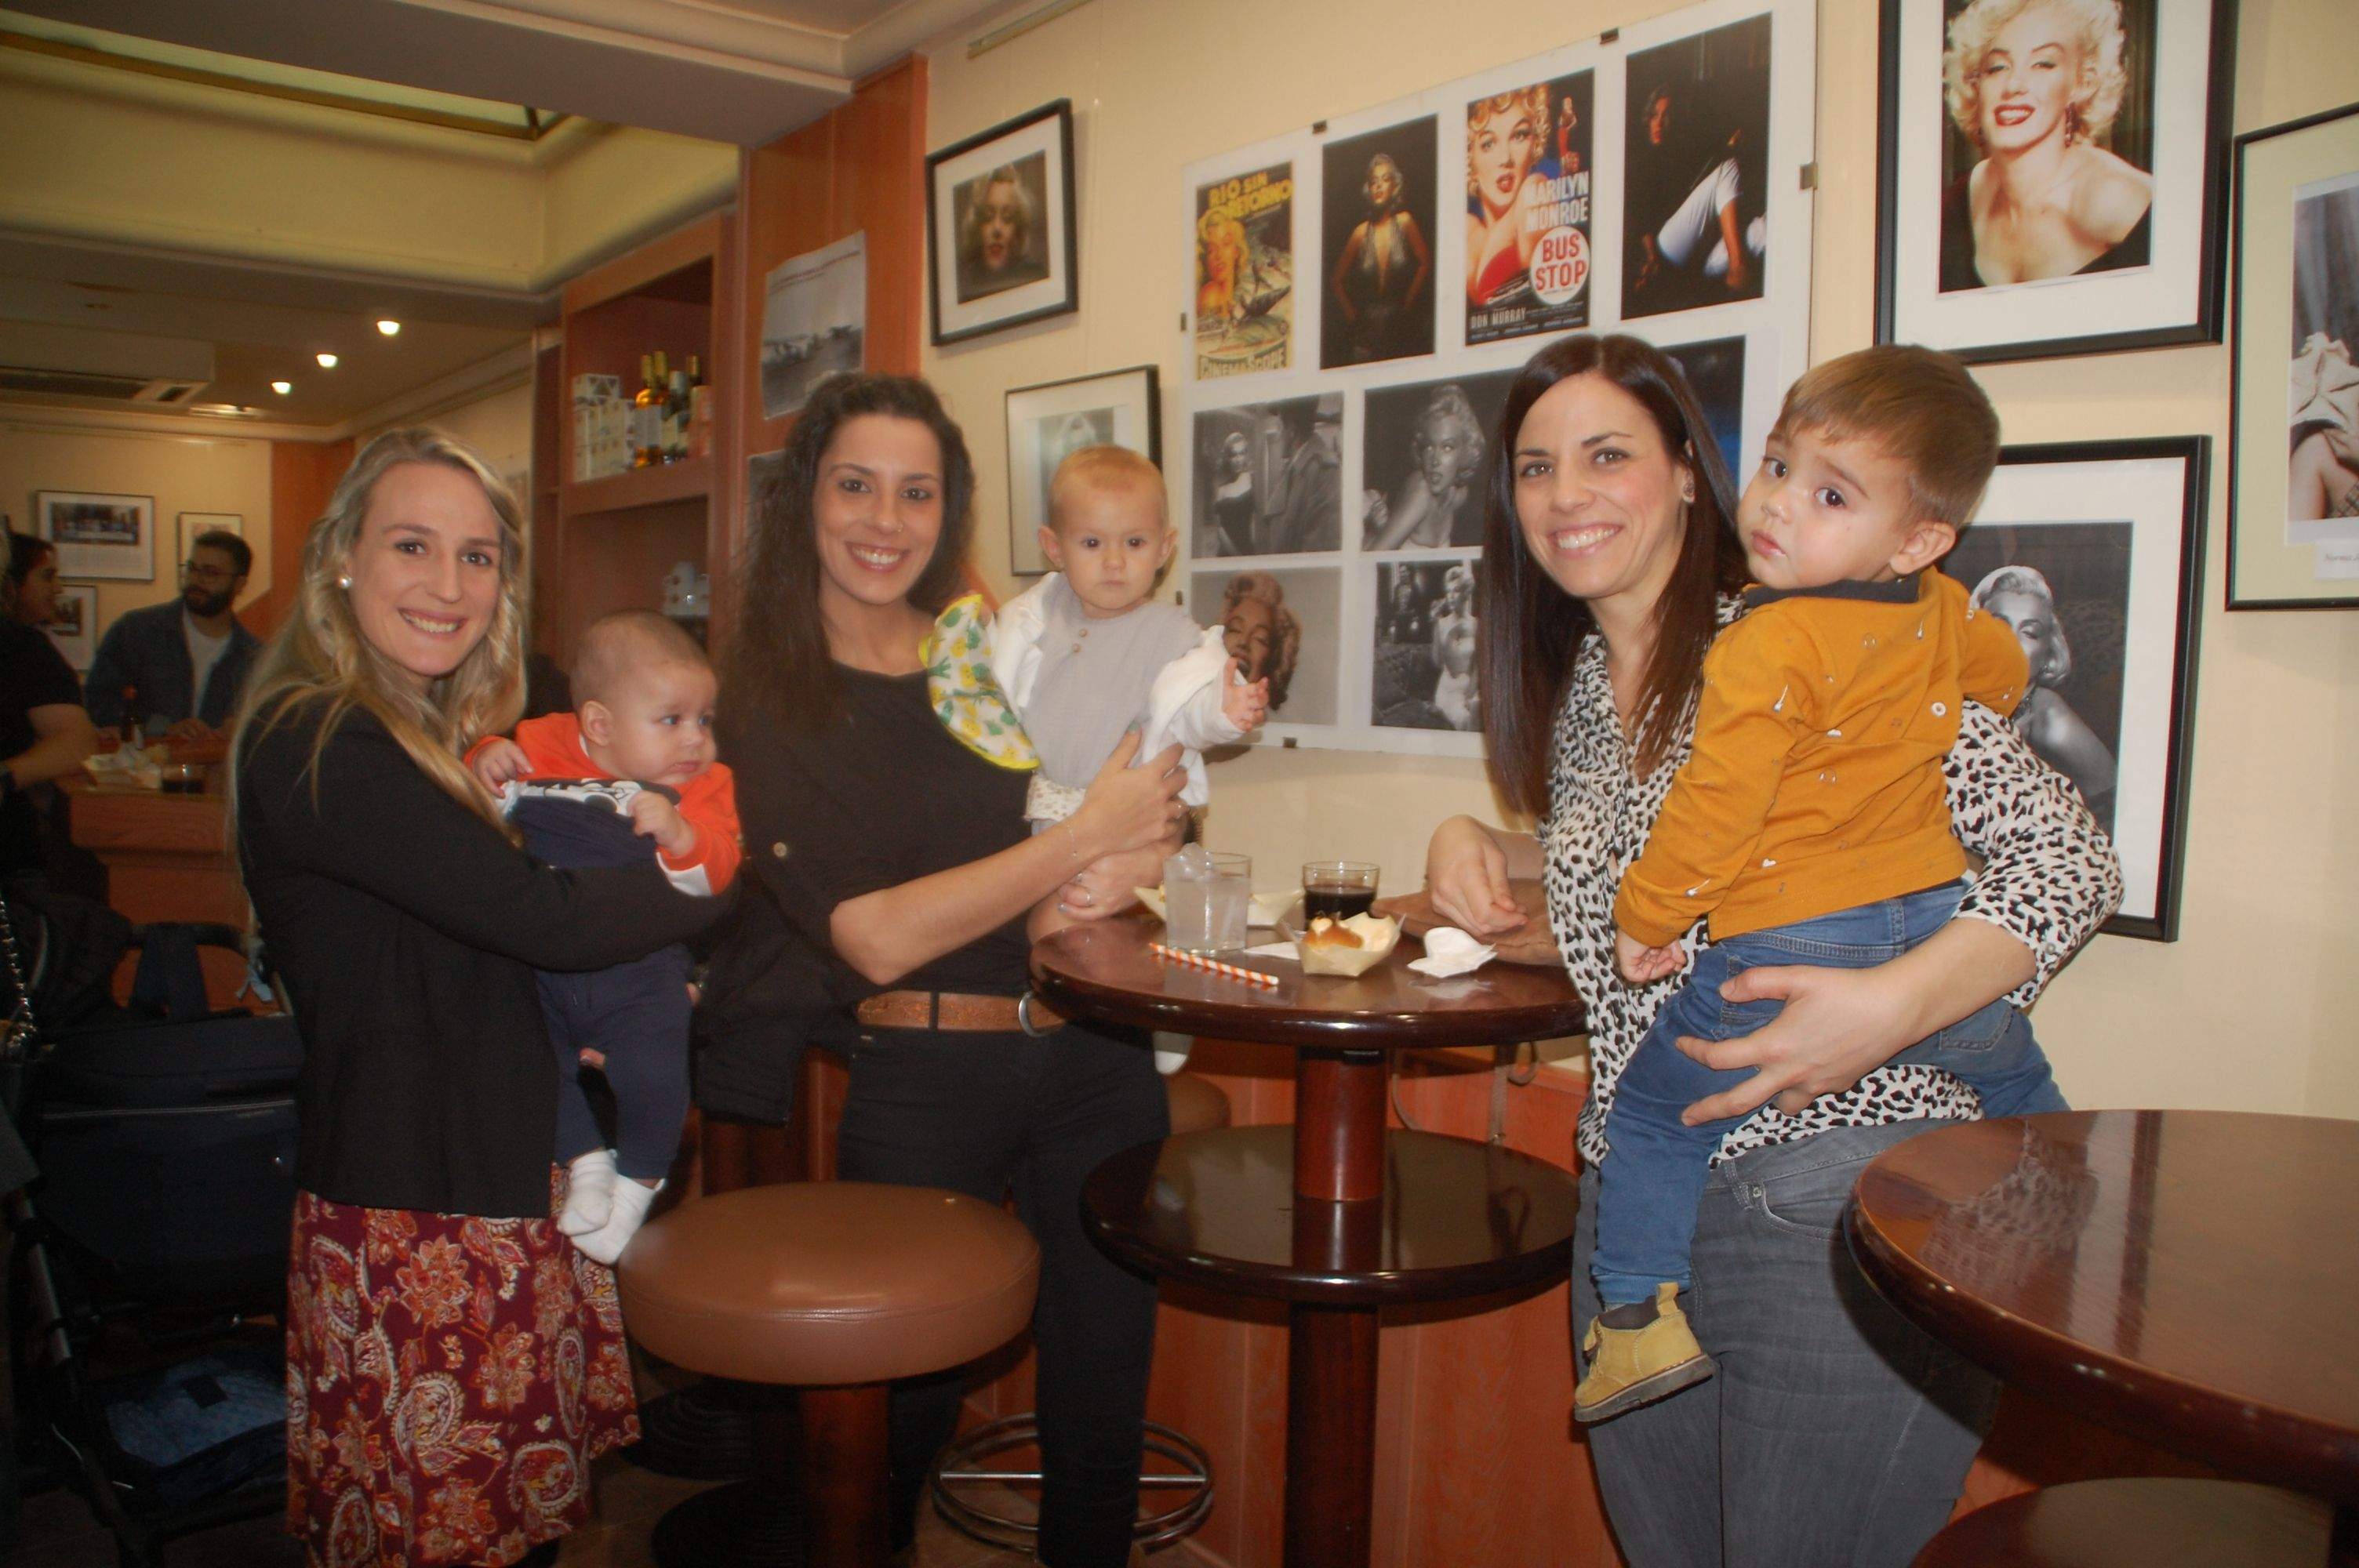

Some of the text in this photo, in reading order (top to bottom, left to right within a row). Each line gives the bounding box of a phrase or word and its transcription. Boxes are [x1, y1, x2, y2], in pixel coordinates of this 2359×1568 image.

[1209, 179, 1241, 209] RIO
[1523, 171, 1590, 204] MARILYN
[1526, 198, 1589, 232] MONROE
[1543, 233, 1580, 263] BUS
[1536, 260, 1587, 291] STOP
[1470, 314, 1488, 329] DON
[1492, 307, 1526, 326] MURRAY
